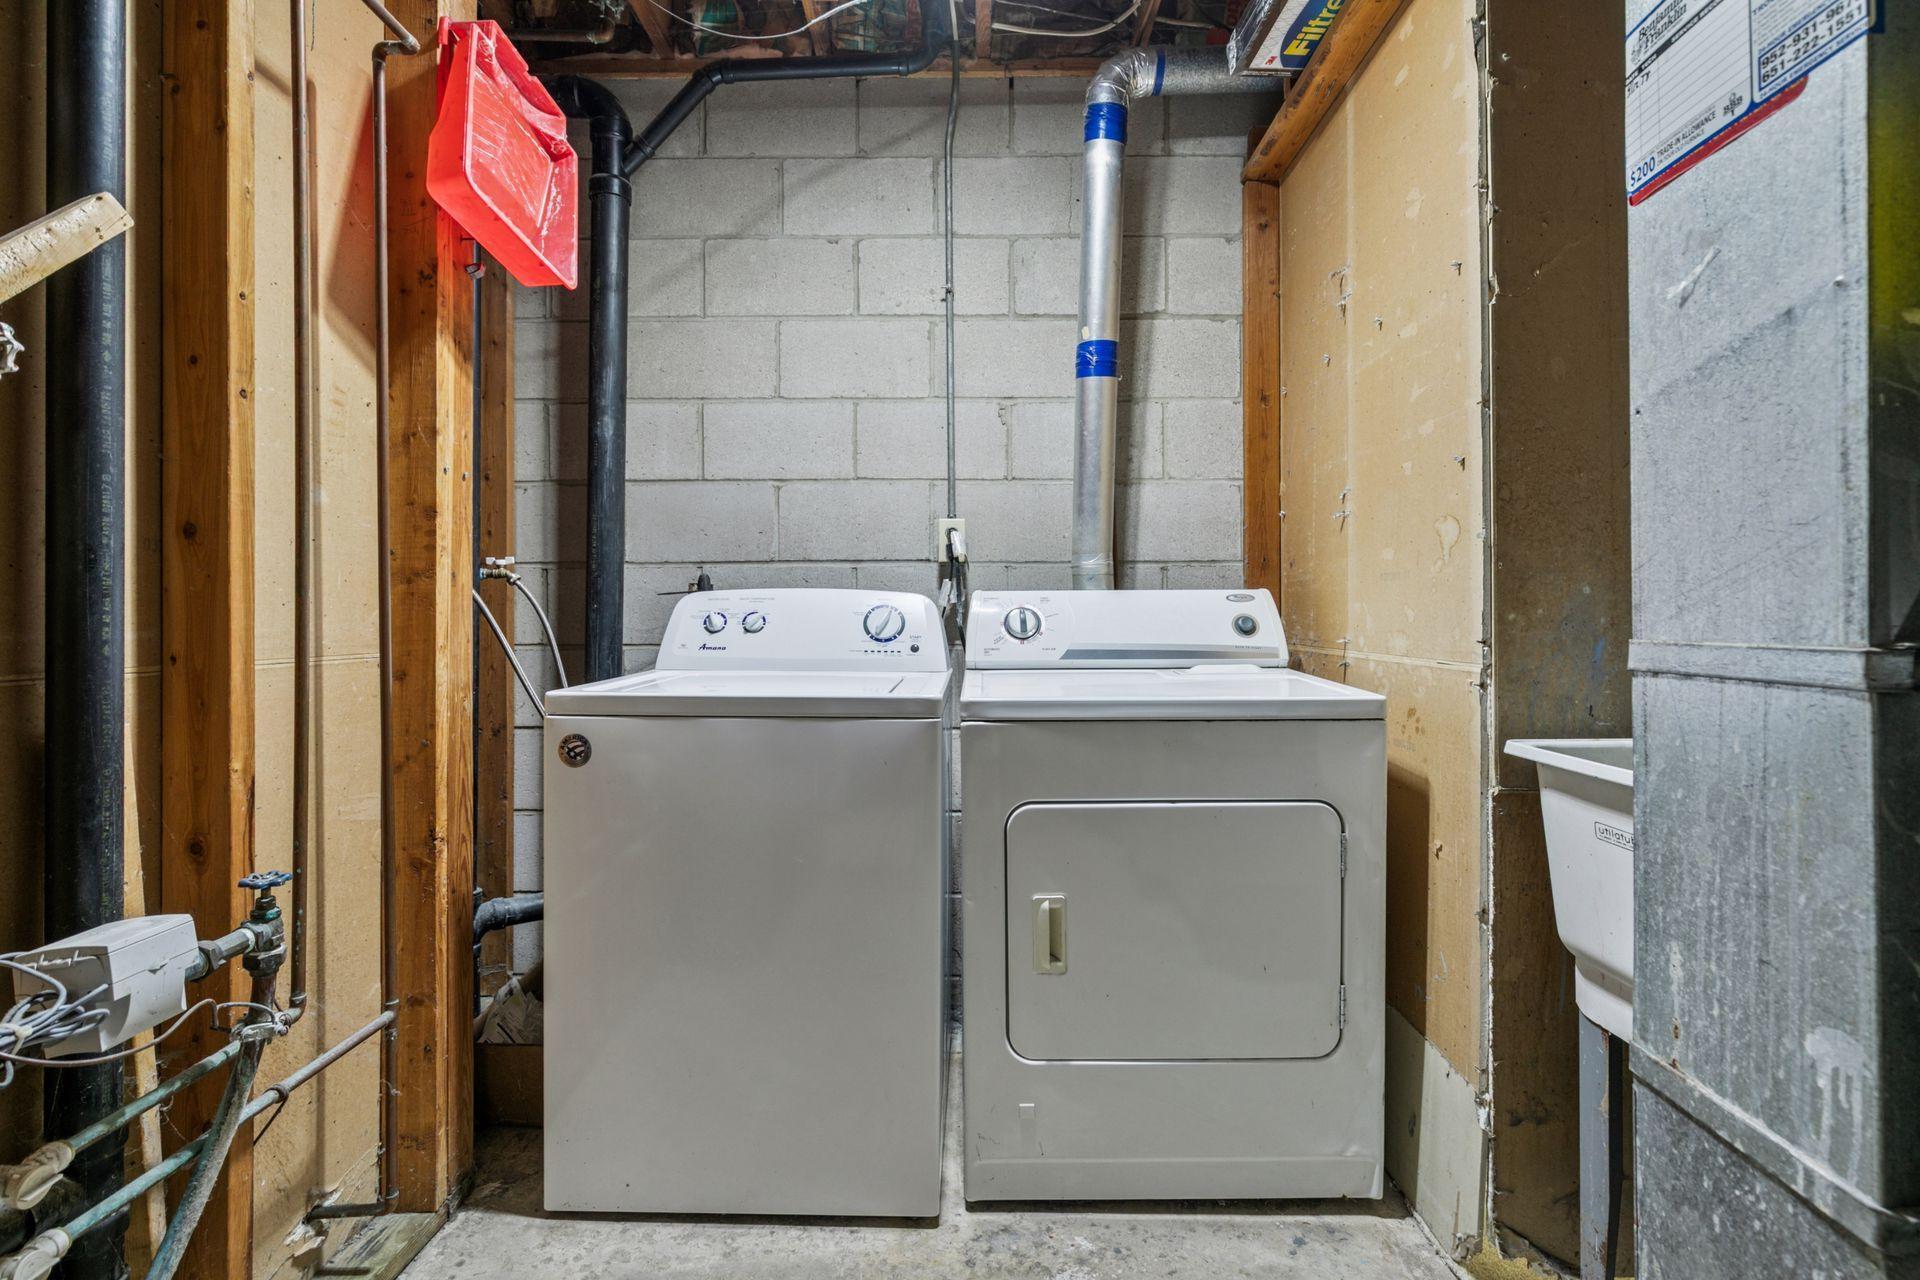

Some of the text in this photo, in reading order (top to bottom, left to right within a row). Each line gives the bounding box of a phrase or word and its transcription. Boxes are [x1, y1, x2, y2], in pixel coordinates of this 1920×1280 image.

[1642, 3, 1687, 50] Franklin
[1761, 0, 1860, 69] 952-931-967
[1761, 4, 1863, 83] 651-222-1551
[1630, 156, 1656, 187] $200
[1681, 110, 1717, 141] ALLOWANCE
[698, 643, 727, 651] Amana
